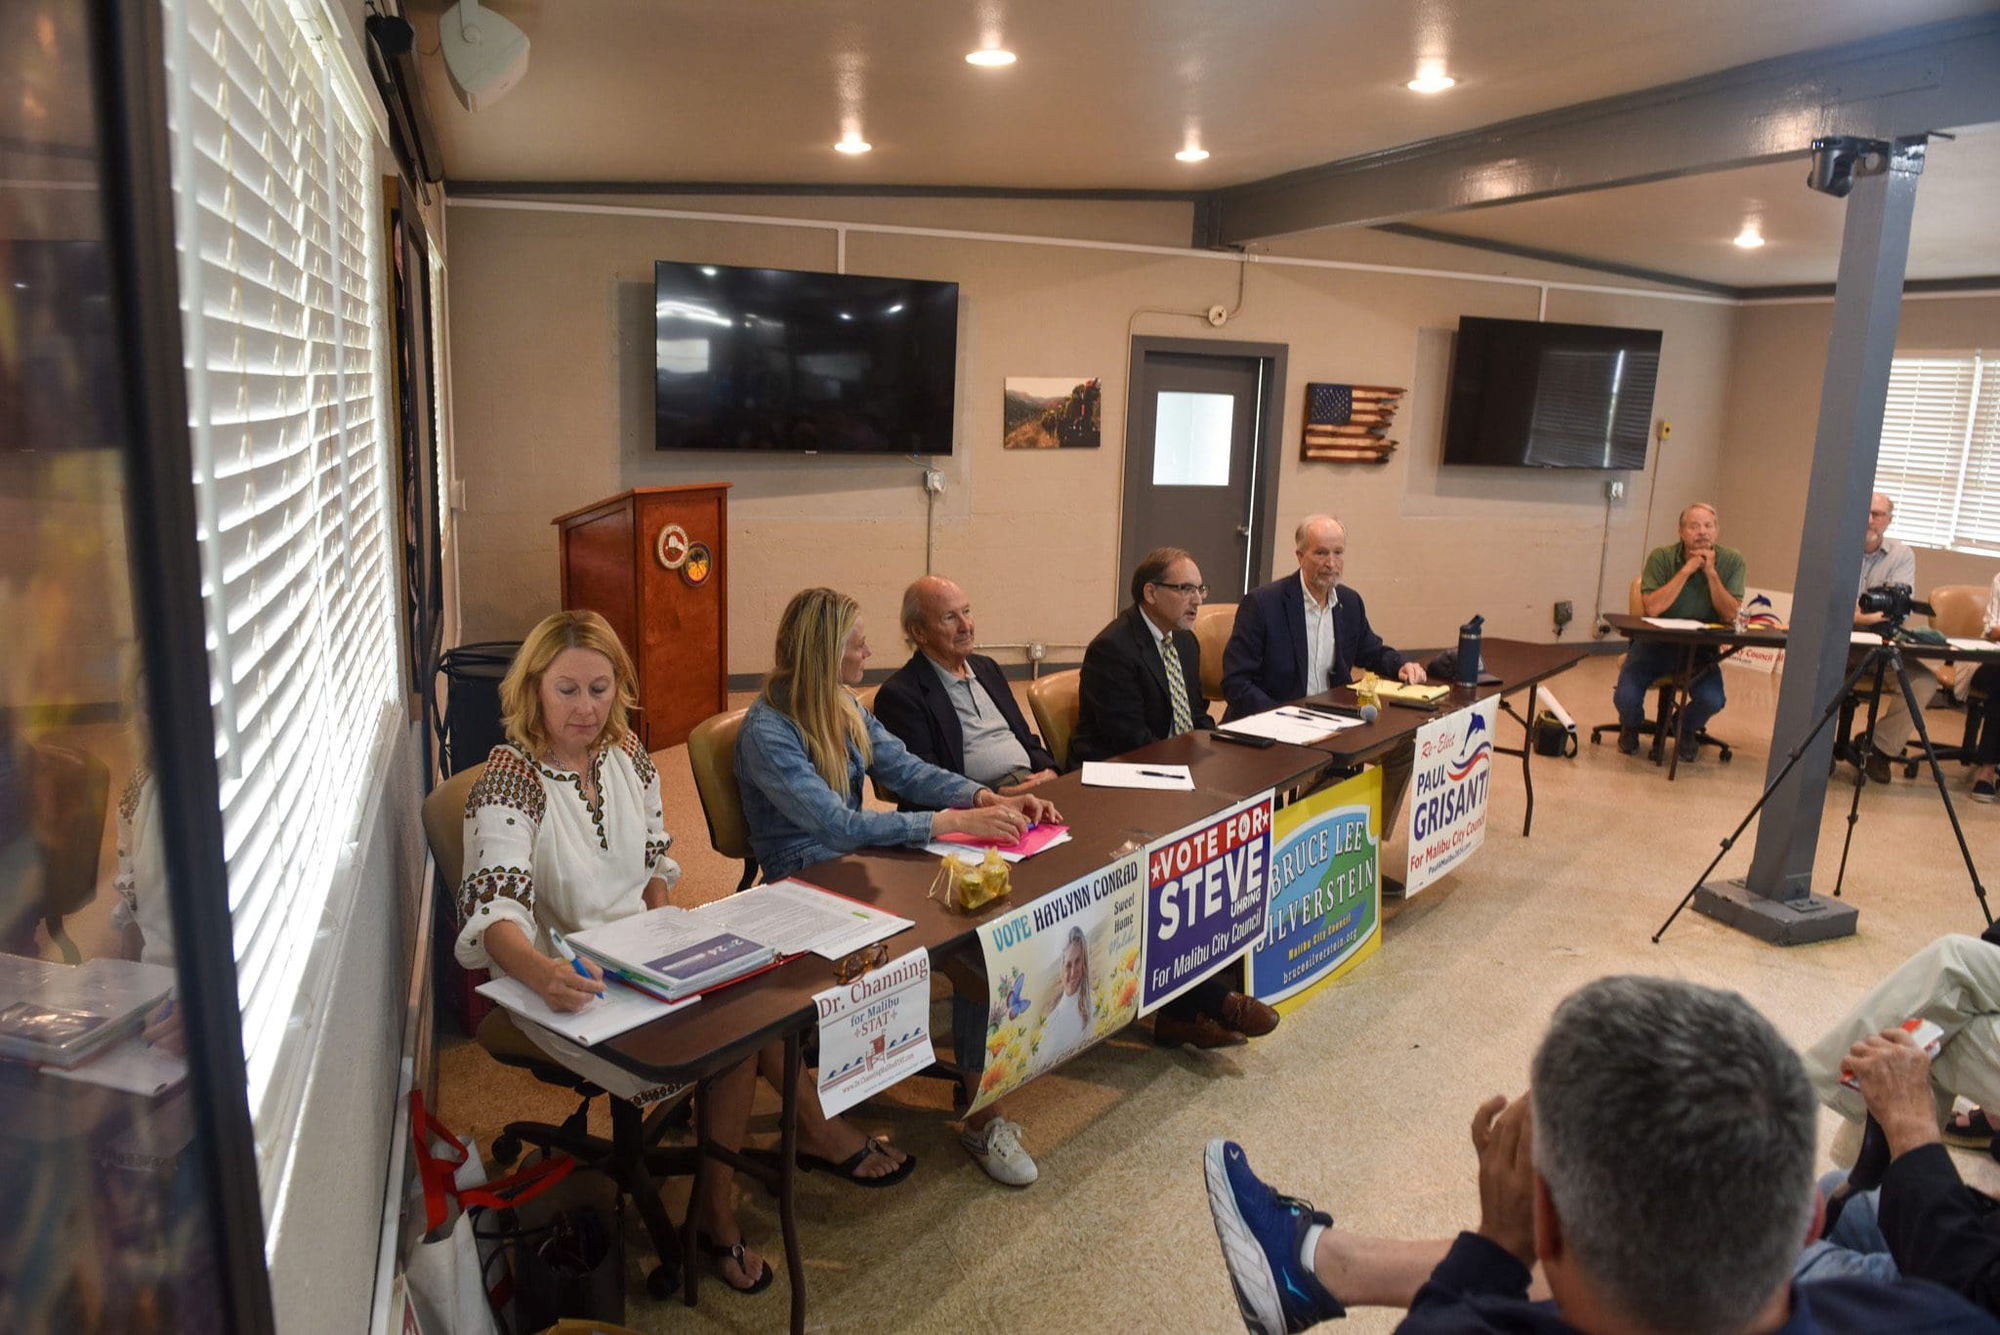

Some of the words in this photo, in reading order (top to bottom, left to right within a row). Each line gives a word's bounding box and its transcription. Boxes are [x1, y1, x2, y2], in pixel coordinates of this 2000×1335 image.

[1414, 766, 1490, 841] GRISANTI
[1417, 764, 1446, 797] PAUL
[1160, 827, 1219, 880] VOTE
[1226, 807, 1263, 849] FOR
[1271, 829, 1328, 899] BRUCE
[1336, 821, 1364, 855] LEE
[1410, 854, 1424, 872] For
[1426, 838, 1451, 862] Malibu
[1452, 827, 1466, 847] City
[992, 914, 1032, 951] VOTE
[1034, 885, 1091, 932] HAYLYNN
[1093, 861, 1139, 901] CONRAD
[1114, 892, 1135, 915] Sweet
[1157, 836, 1264, 940] STEVE
[1231, 888, 1261, 918] UHRING
[1114, 914, 1134, 934] Home
[1152, 966, 1171, 991] For
[1174, 944, 1210, 979] Malibu
[1212, 931, 1229, 956] City
[1232, 906, 1262, 943] Council
[1283, 928, 1357, 985] brucesilverstein.org
[819, 996, 845, 1019] Dr.
[850, 957, 928, 1004] Channing
[851, 1012, 865, 1027] for
[867, 997, 900, 1018] Malibu
